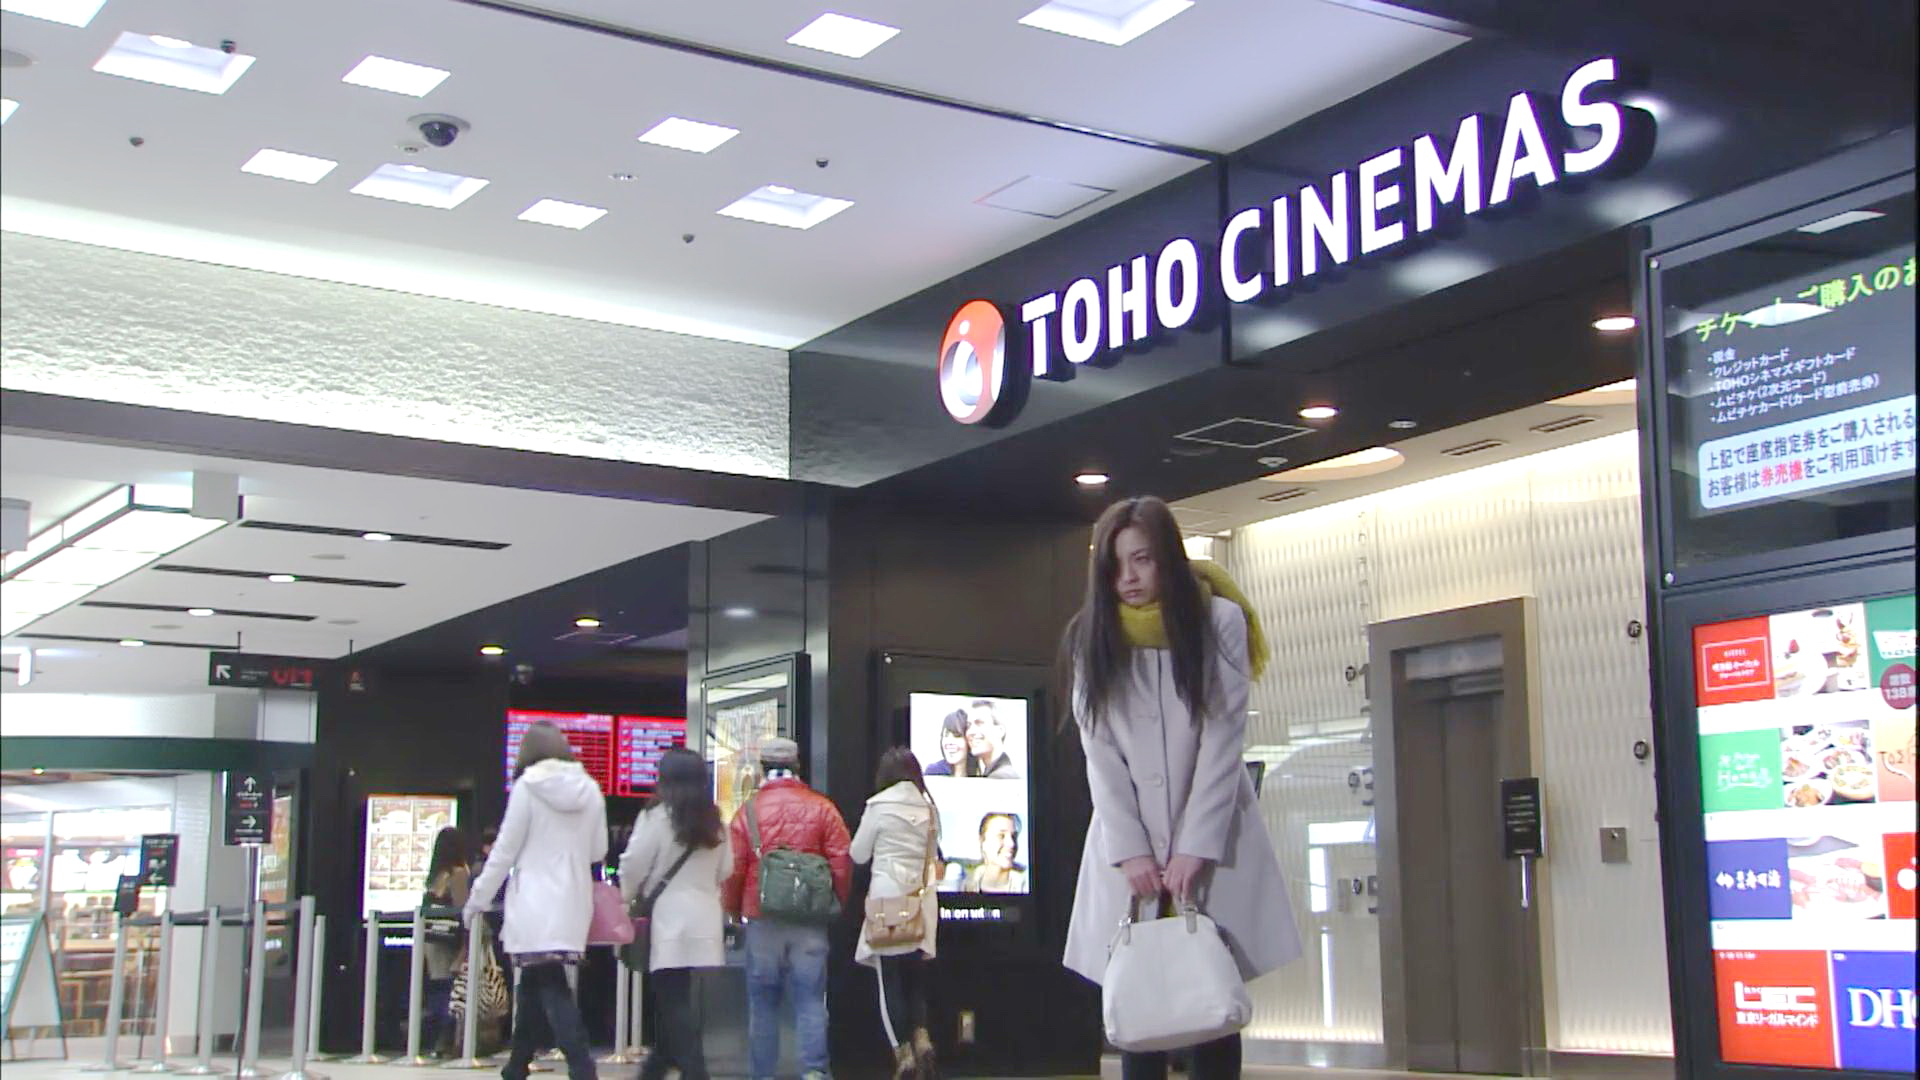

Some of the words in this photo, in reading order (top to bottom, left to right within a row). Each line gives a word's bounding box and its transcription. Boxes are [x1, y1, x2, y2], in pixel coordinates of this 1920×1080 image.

[1021, 238, 1199, 378] TOHO
[1219, 57, 1625, 303] CINEMAS
[1847, 987, 1915, 1029] DH
